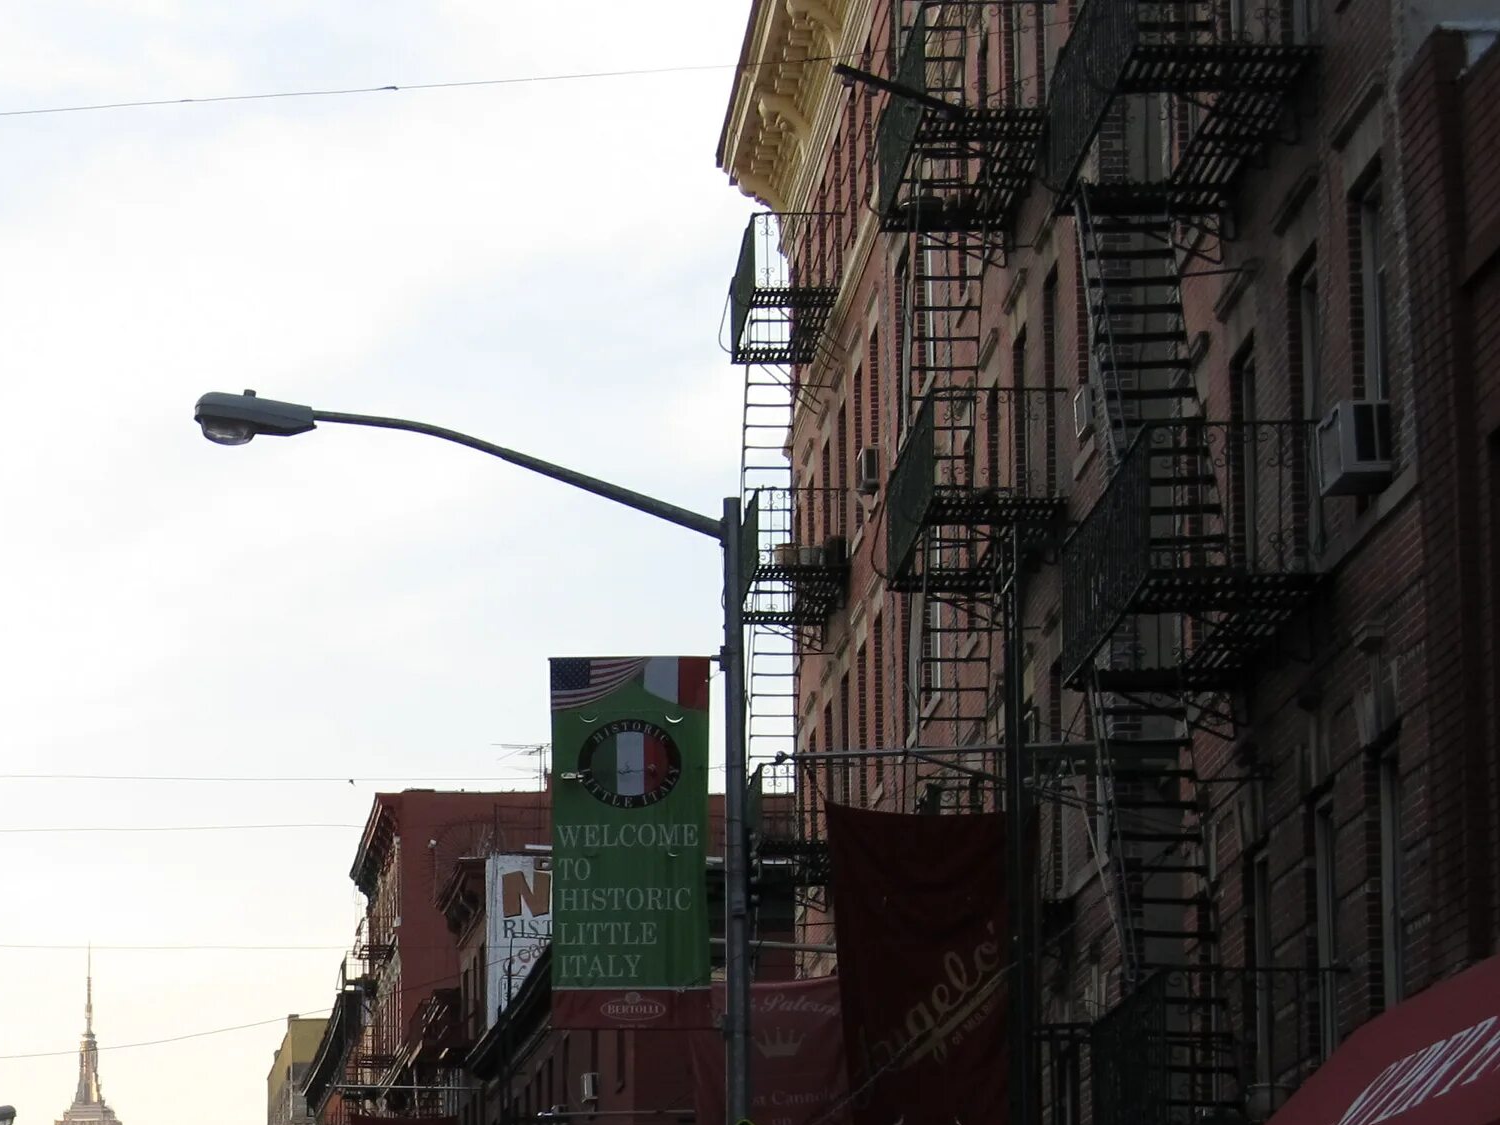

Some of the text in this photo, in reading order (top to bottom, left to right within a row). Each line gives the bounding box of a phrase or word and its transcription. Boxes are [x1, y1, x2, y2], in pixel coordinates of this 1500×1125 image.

[592, 721, 669, 744] HISTORIC
[582, 764, 680, 808] LITTLE ITALY
[556, 823, 699, 849] WELCOME
[558, 857, 591, 881] TO
[559, 887, 692, 912] HISTORIC
[558, 921, 658, 946] LITTLE
[559, 954, 642, 978] ITALY
[607, 1003, 660, 1014] BERTOLLI
